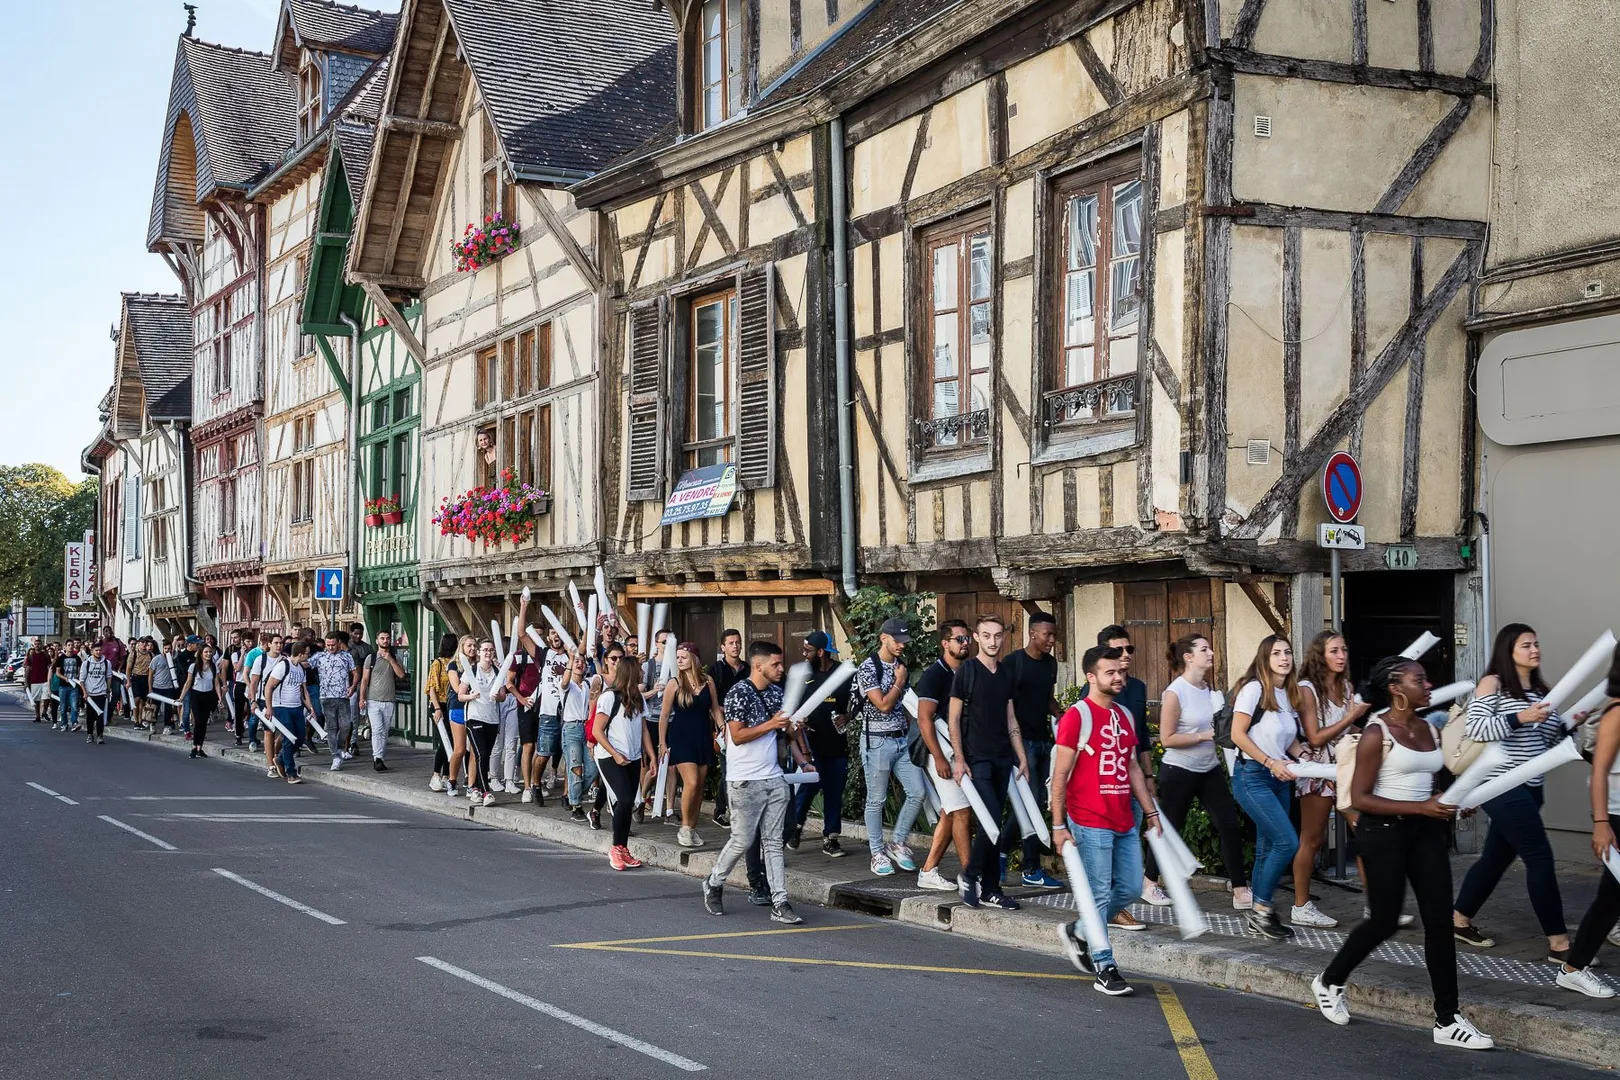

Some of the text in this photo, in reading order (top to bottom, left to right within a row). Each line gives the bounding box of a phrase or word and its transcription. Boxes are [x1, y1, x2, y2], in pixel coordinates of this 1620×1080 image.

[679, 485, 715, 502] VENDRE
[1394, 549, 1409, 566] 40
[69, 546, 80, 599] KEBAB
[1099, 750, 1128, 781] BS
